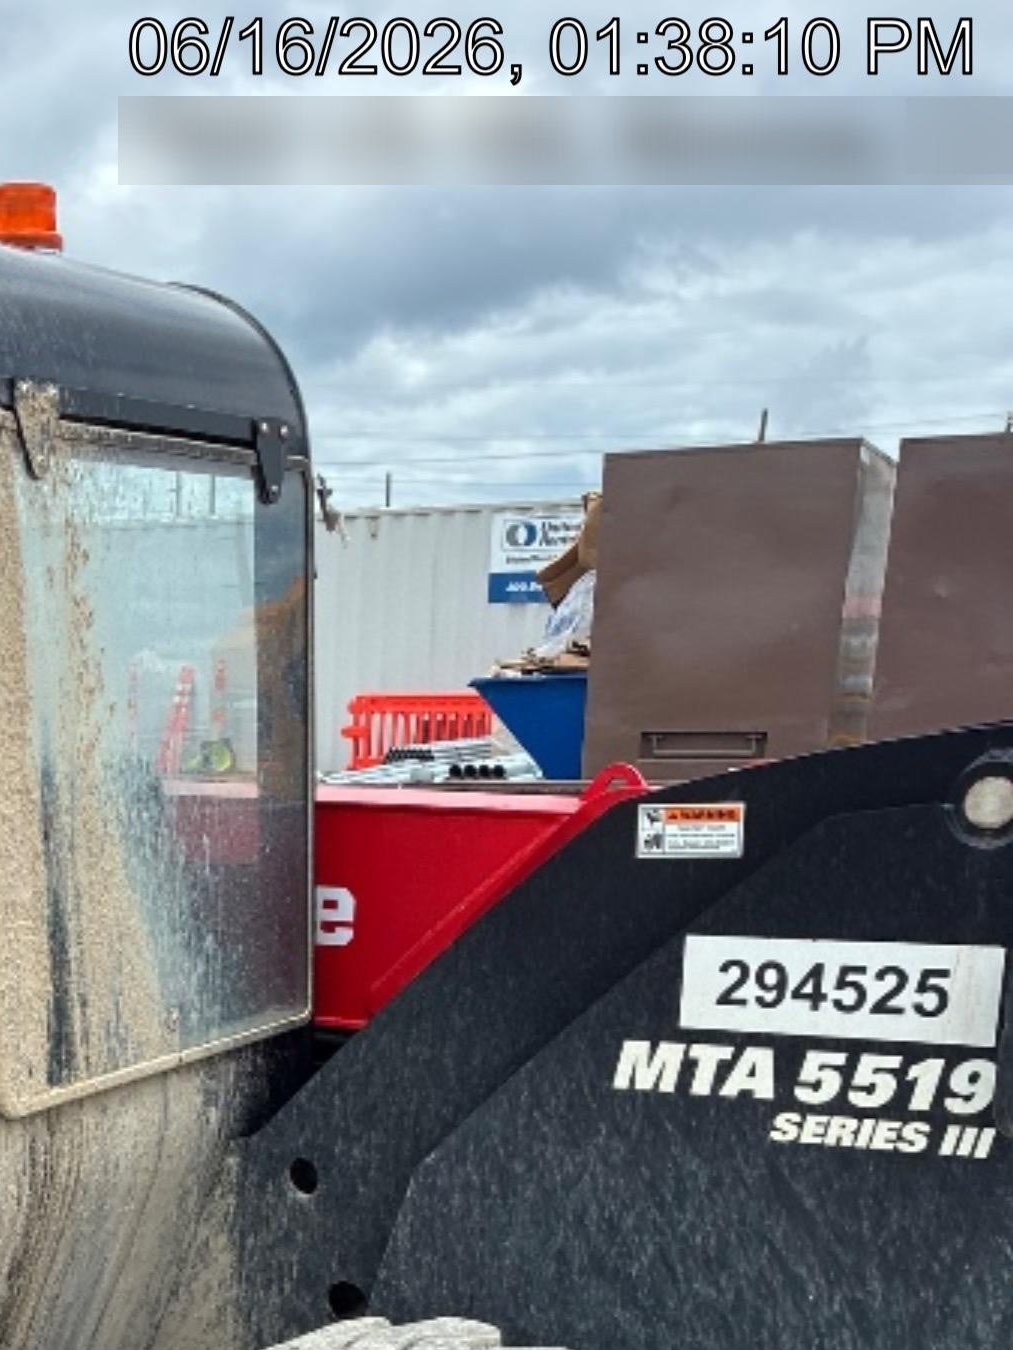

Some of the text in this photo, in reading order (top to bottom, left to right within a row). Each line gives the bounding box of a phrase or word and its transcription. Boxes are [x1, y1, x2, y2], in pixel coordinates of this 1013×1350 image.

[716, 958, 951, 1018] 294525
[613, 1040, 998, 1115] MTA 5519
[770, 1112, 997, 1159] SERIES III
